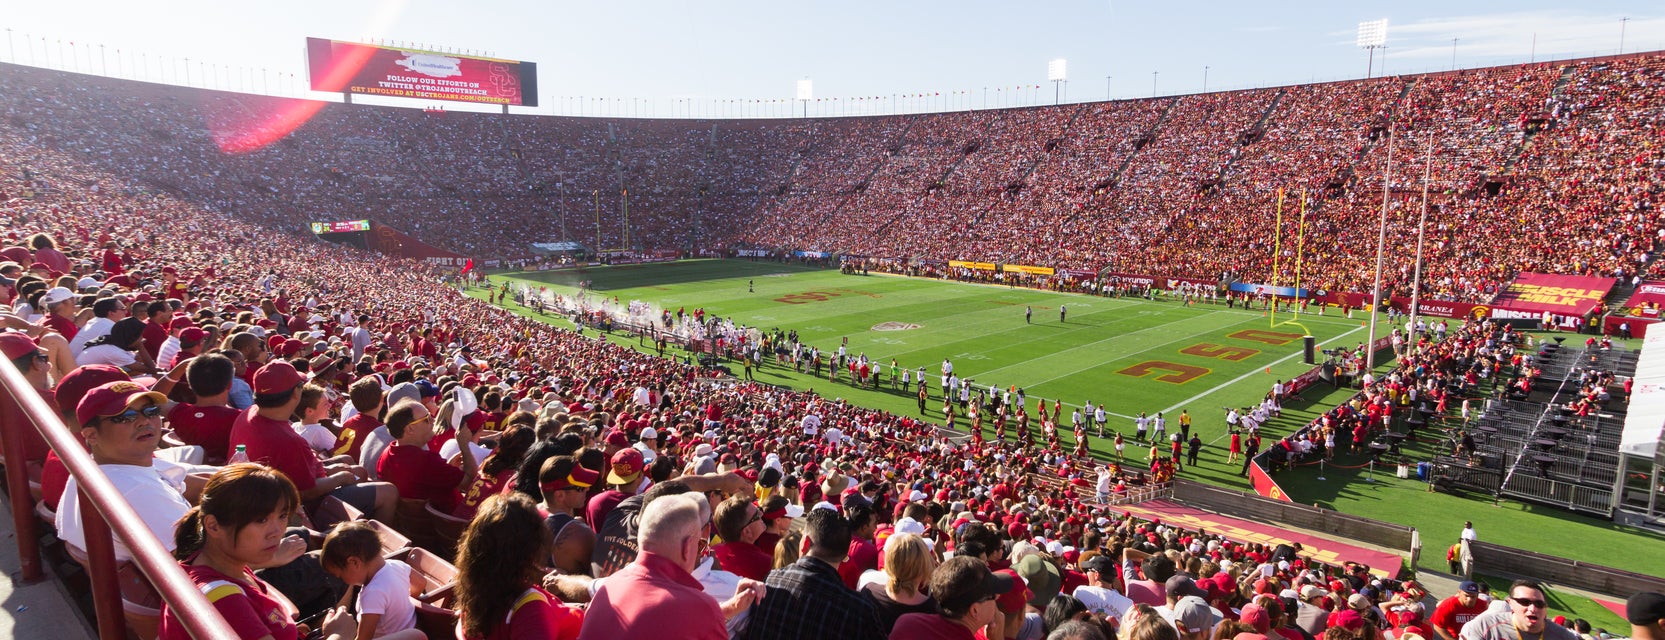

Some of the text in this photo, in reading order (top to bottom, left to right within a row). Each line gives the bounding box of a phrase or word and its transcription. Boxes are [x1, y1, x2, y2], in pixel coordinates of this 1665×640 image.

[387, 75, 418, 83] FOLLOW
[420, 77, 436, 85] OUR
[437, 79, 468, 87] EFFORTS
[367, 87, 404, 96] INVOLVED
[379, 81, 488, 95] TWITTER @TROJANOUTREACH
[1122, 276, 1154, 285] HYUNDAI
[1507, 283, 1605, 299] MUSCLE
[1516, 293, 1580, 307] MILK
[1407, 303, 1455, 314] TRRANEA
[332, 428, 357, 457] 2
